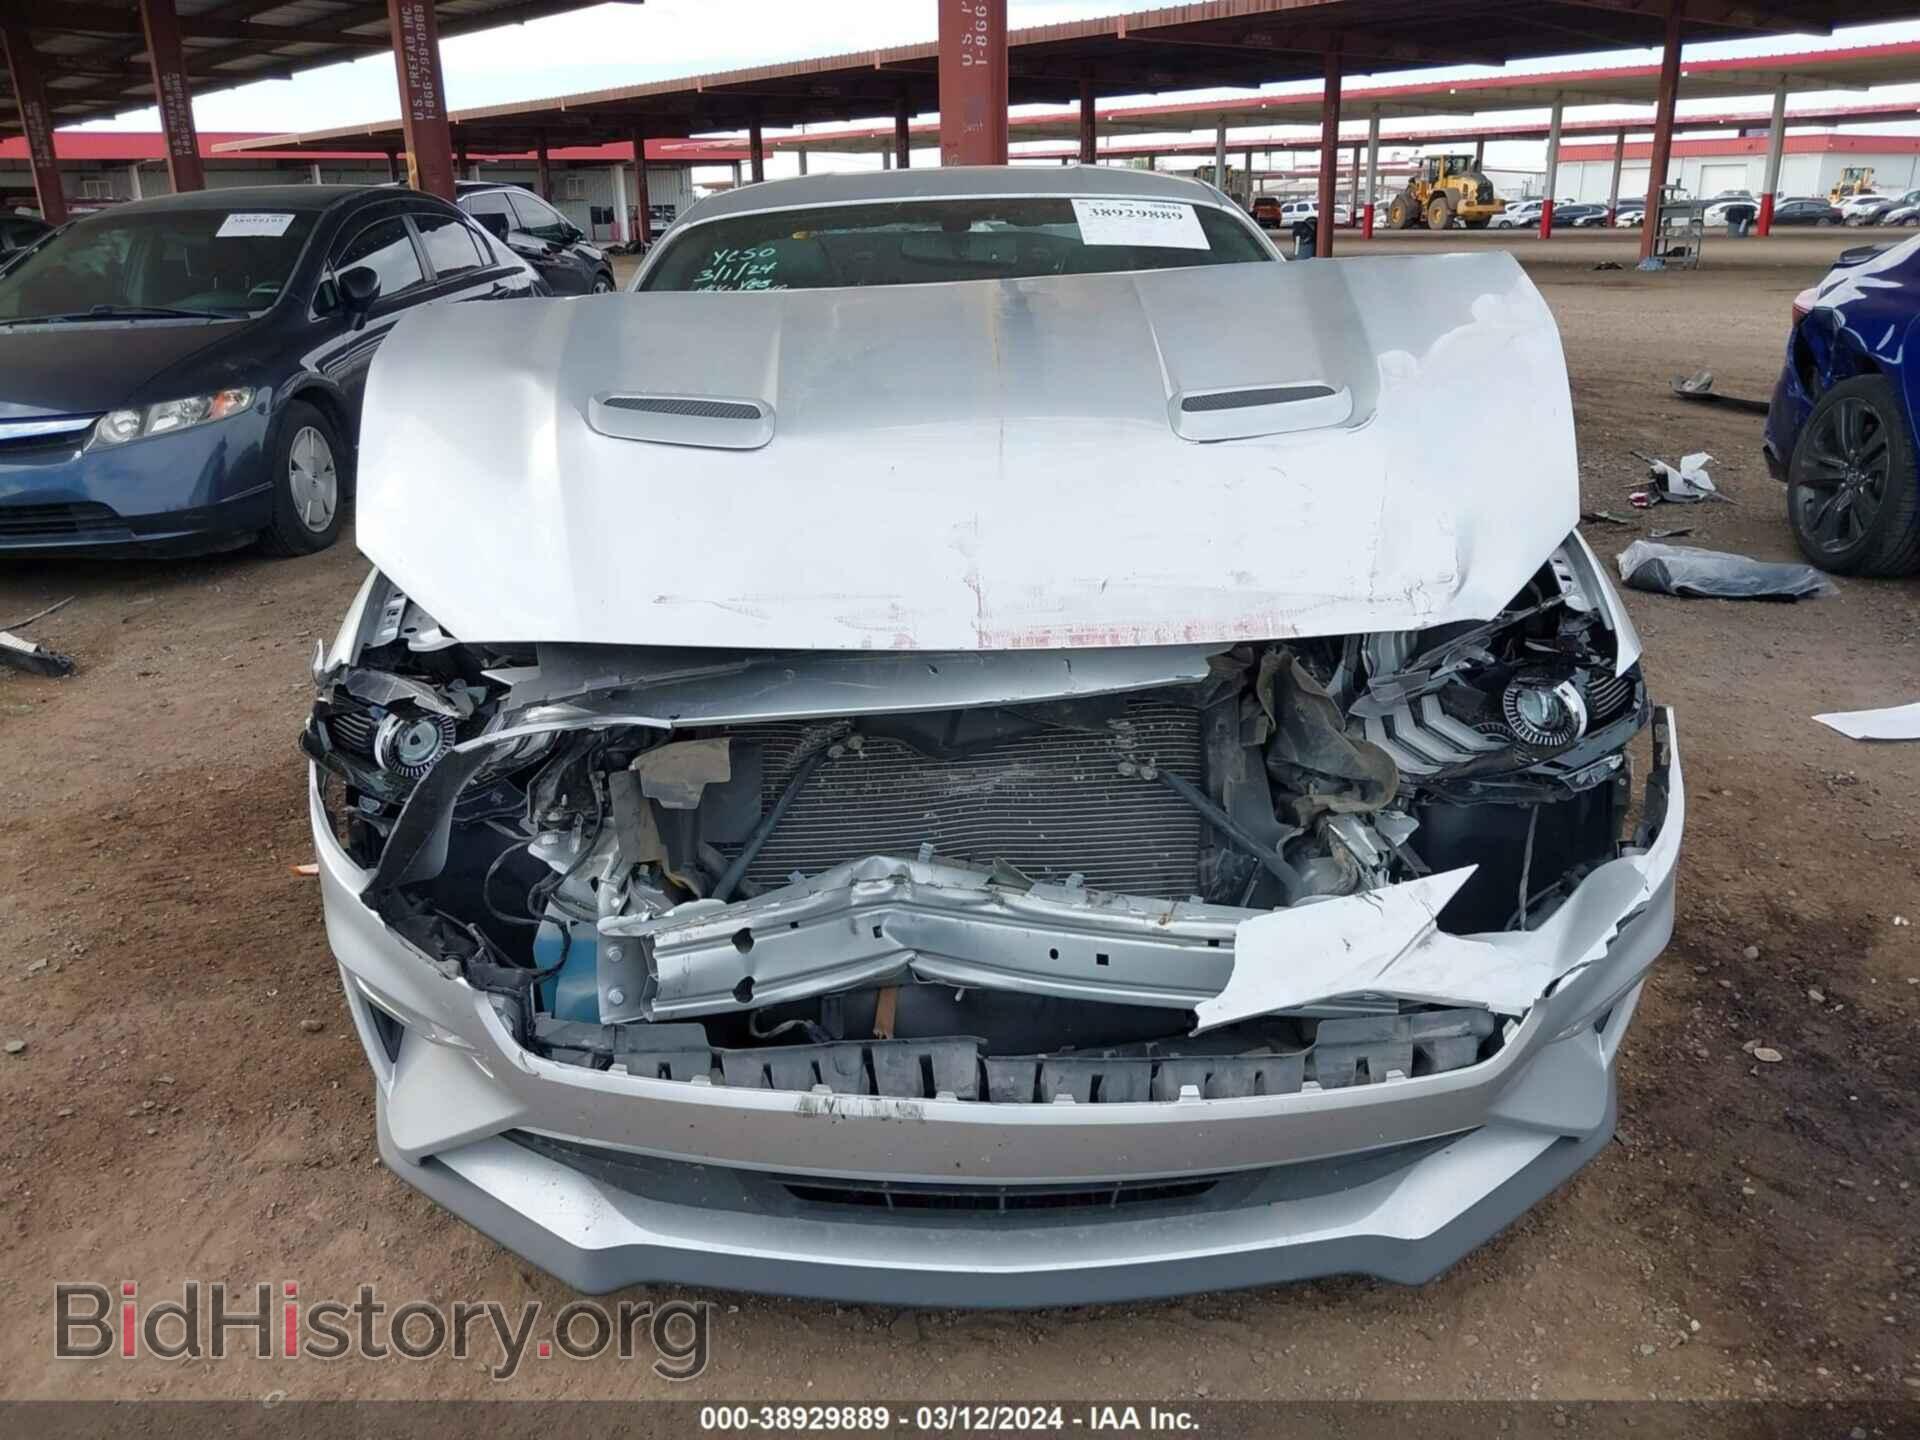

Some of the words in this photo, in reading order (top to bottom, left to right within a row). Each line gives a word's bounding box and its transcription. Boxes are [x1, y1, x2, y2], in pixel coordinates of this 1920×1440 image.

[961, 27, 973, 66] U.S.
[404, 36, 421, 88] PREFAB
[1089, 208, 1183, 220] 38929889
[712, 247, 776, 266] YCSO
[693, 262, 778, 281] 3/1/24
